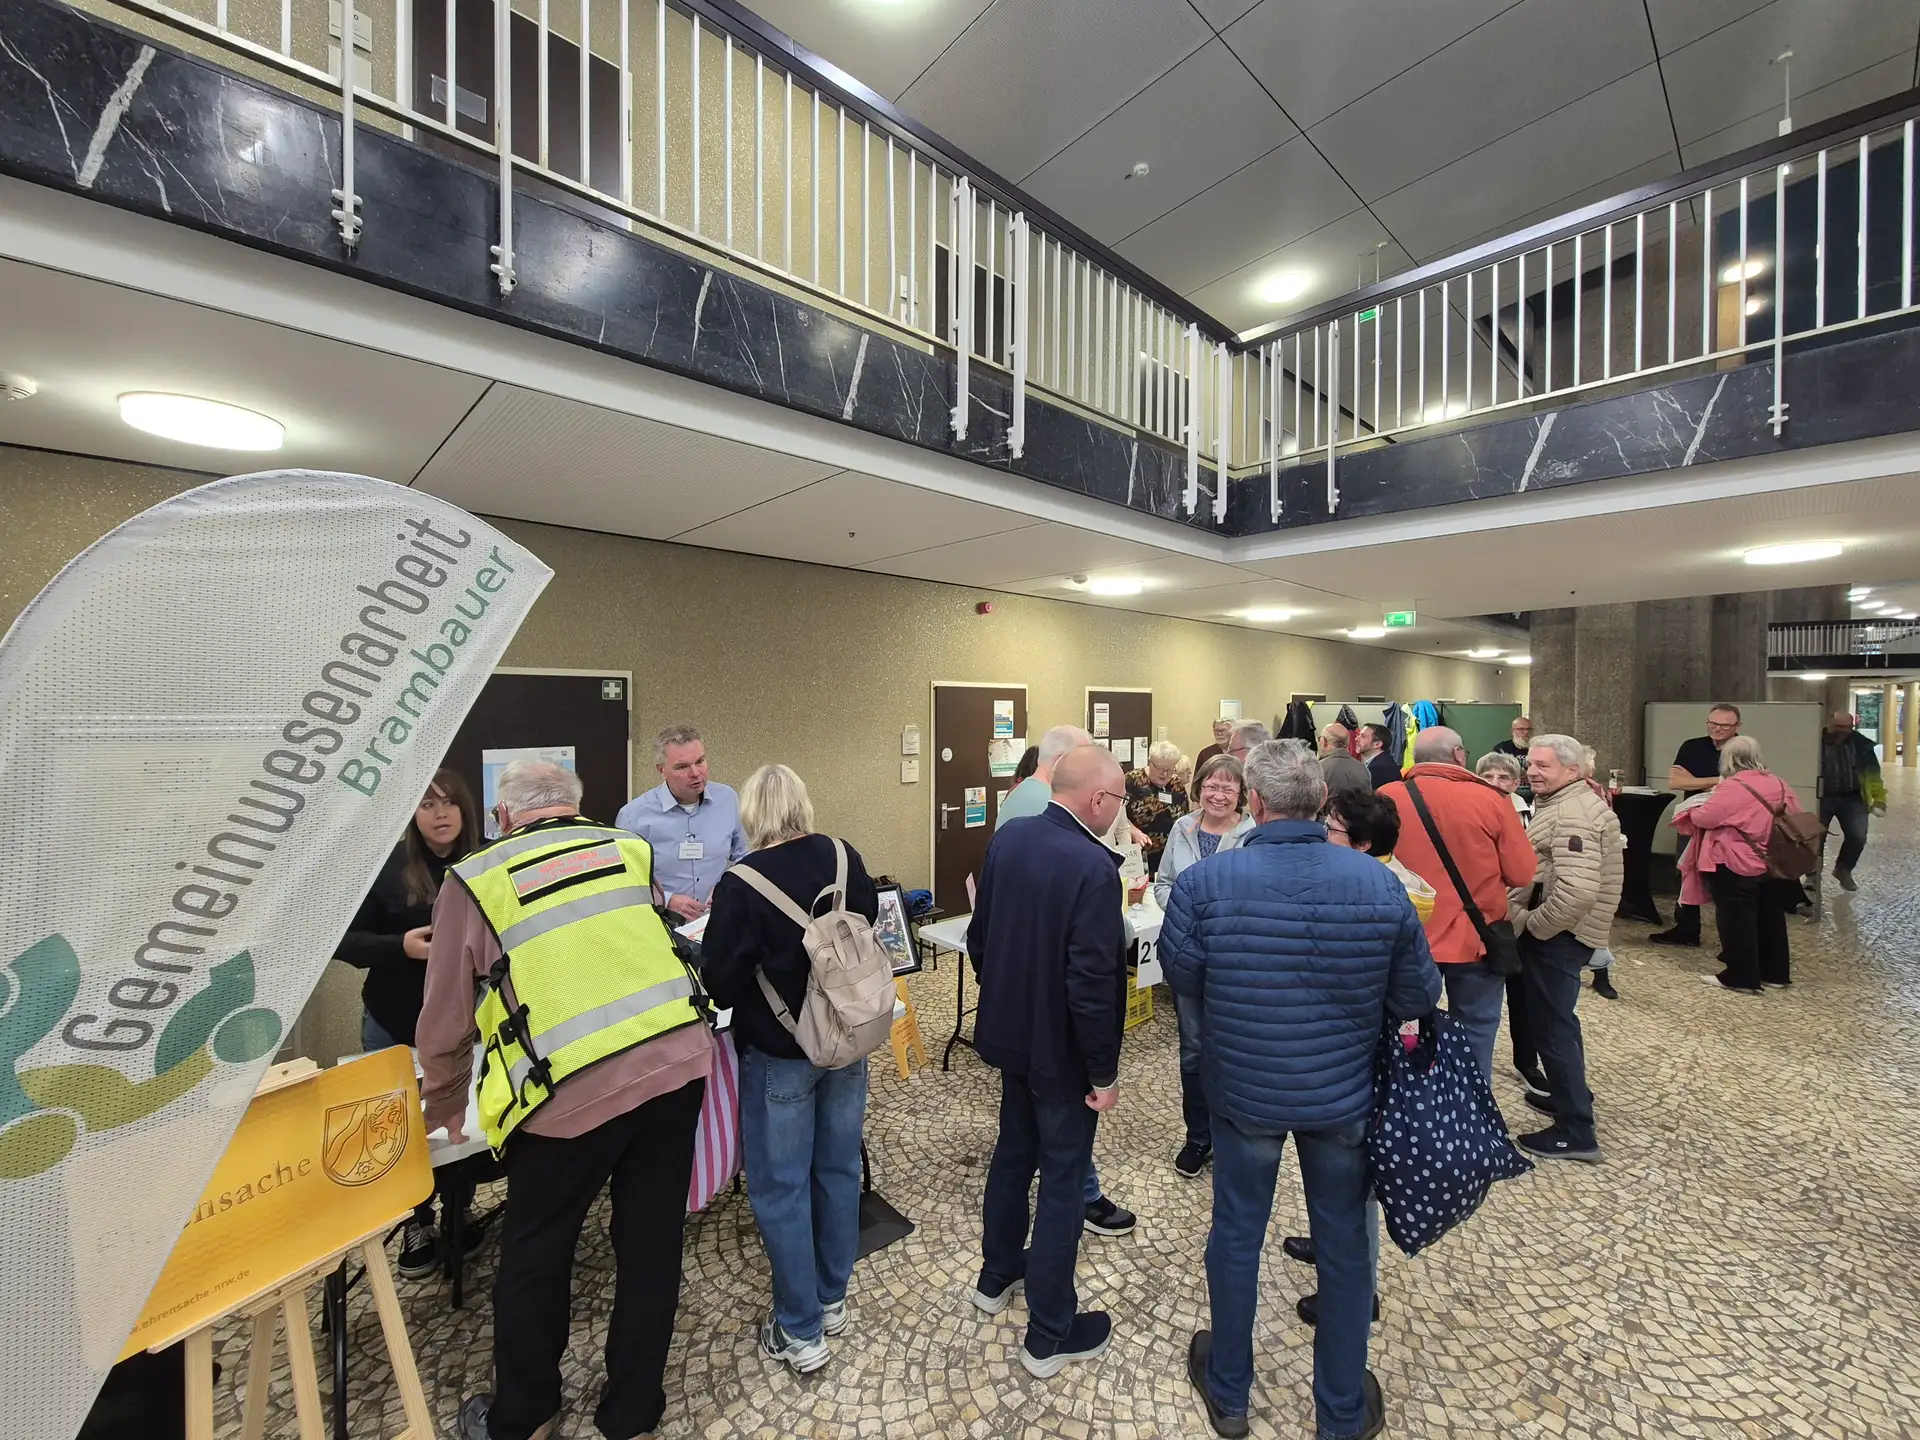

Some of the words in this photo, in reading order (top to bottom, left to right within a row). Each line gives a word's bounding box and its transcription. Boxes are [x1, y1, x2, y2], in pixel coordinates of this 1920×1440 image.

[61, 517, 471, 1051] Gemeinwesenarbeit
[337, 545, 515, 798] Brambauer
[183, 1158, 312, 1229] nsache
